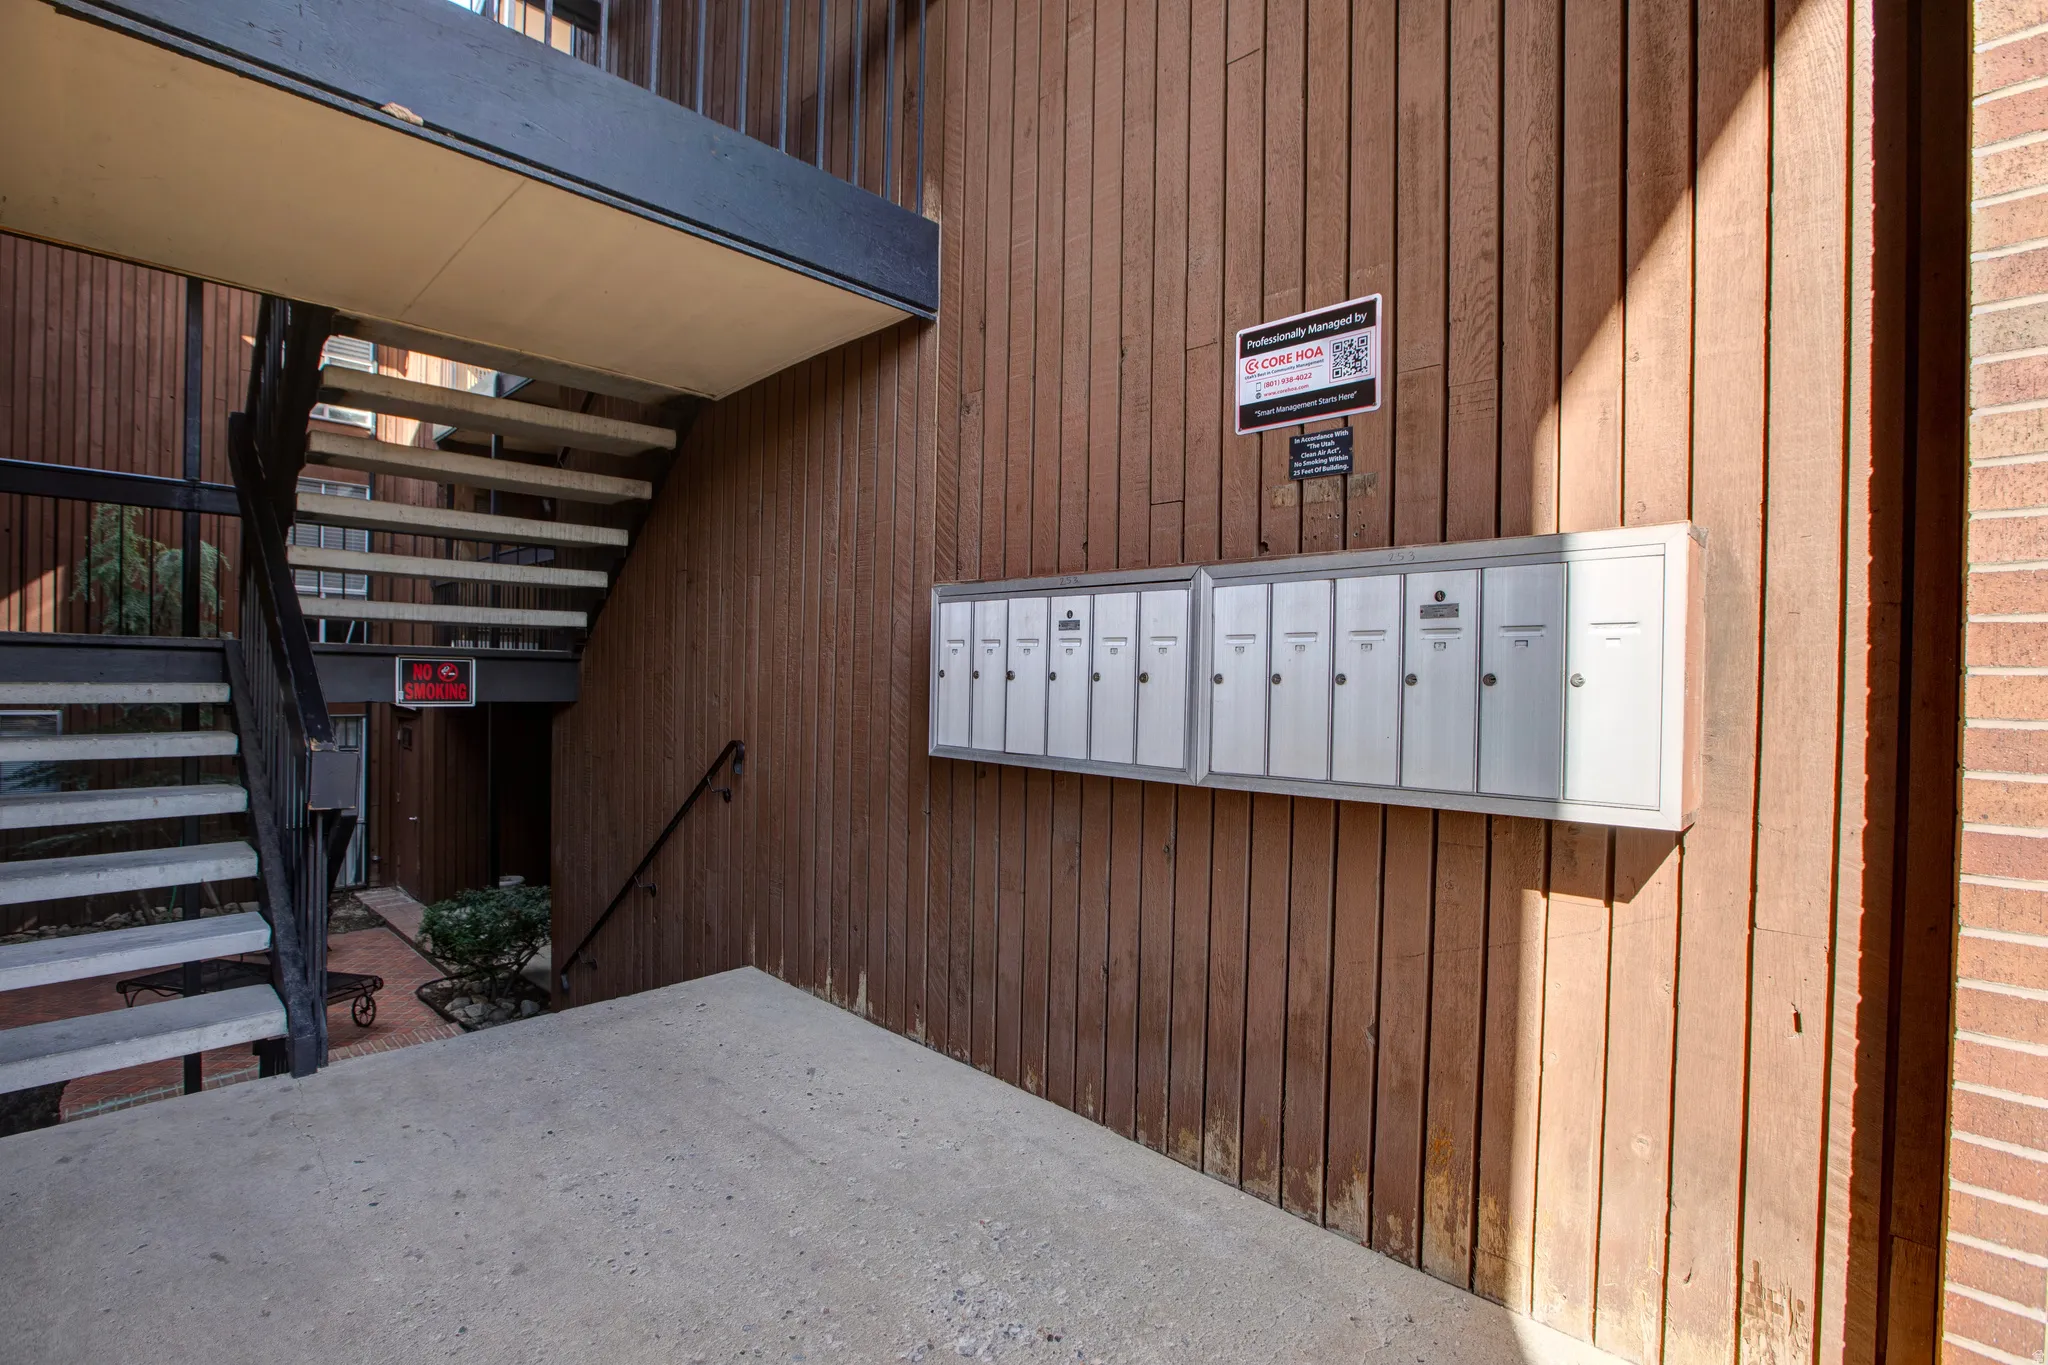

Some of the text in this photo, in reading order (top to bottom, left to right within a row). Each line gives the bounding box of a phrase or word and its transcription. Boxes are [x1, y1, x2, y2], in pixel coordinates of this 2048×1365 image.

[1247, 312, 1368, 349] Professionally Managed by
[1261, 346, 1324, 369] CORE HOA
[1272, 365, 1295, 374] Community
[1296, 359, 1324, 368] Management
[1264, 372, 1312, 389] (801) 938-4022
[1264, 384, 1309, 397] www.corehoa.com
[1276, 398, 1317, 413] Management
[1318, 396, 1338, 405] Starts
[1301, 433, 1334, 443] Accordance
[1303, 458, 1328, 467] Smoking
[1322, 464, 1349, 472] Building.
[413, 663, 432, 681] NO
[404, 682, 467, 700] SMOKING
